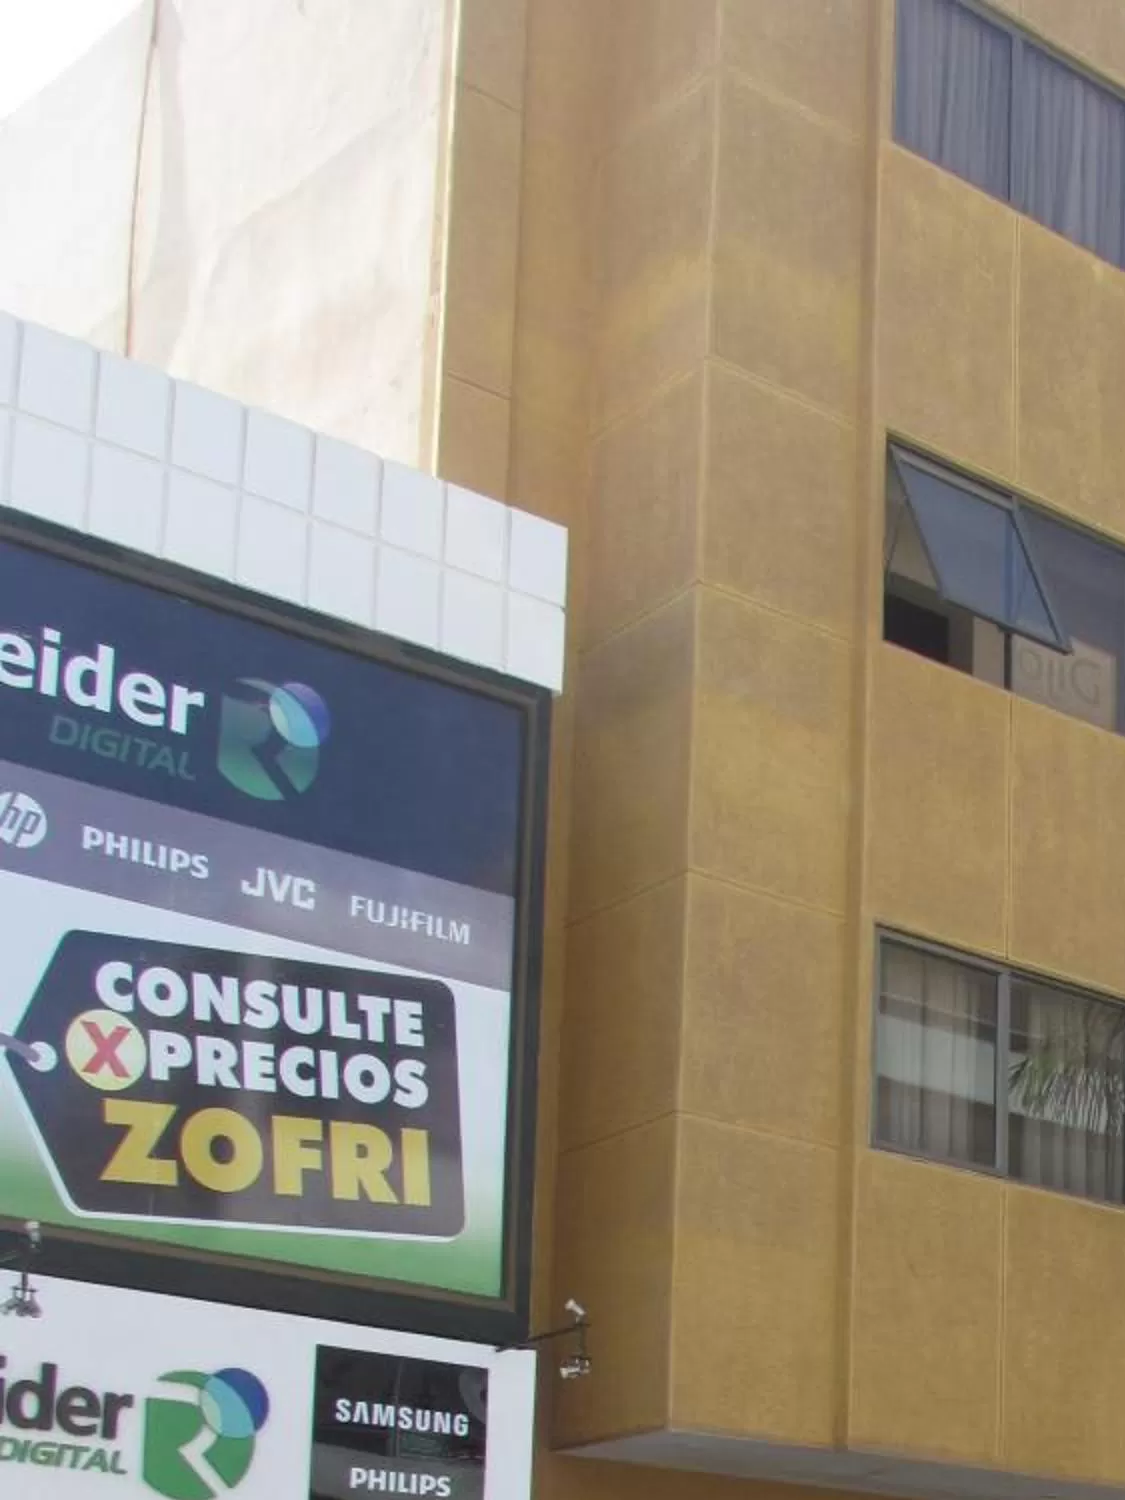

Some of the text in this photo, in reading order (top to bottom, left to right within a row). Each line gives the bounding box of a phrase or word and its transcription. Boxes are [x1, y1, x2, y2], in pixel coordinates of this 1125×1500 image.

[49, 715, 196, 781] DIGITAL
[82, 824, 209, 880] PHILIPS
[240, 867, 316, 910] JVC
[351, 895, 471, 945] FUJIFILM
[95, 961, 426, 1048] CONSULTE
[148, 1030, 429, 1108] PRECIOS
[100, 1097, 432, 1206] ZOFRI
[335, 1398, 470, 1437] SAMSUNG
[0, 1435, 128, 1475] DIGITAL
[350, 1467, 452, 1498] PHILIPS
